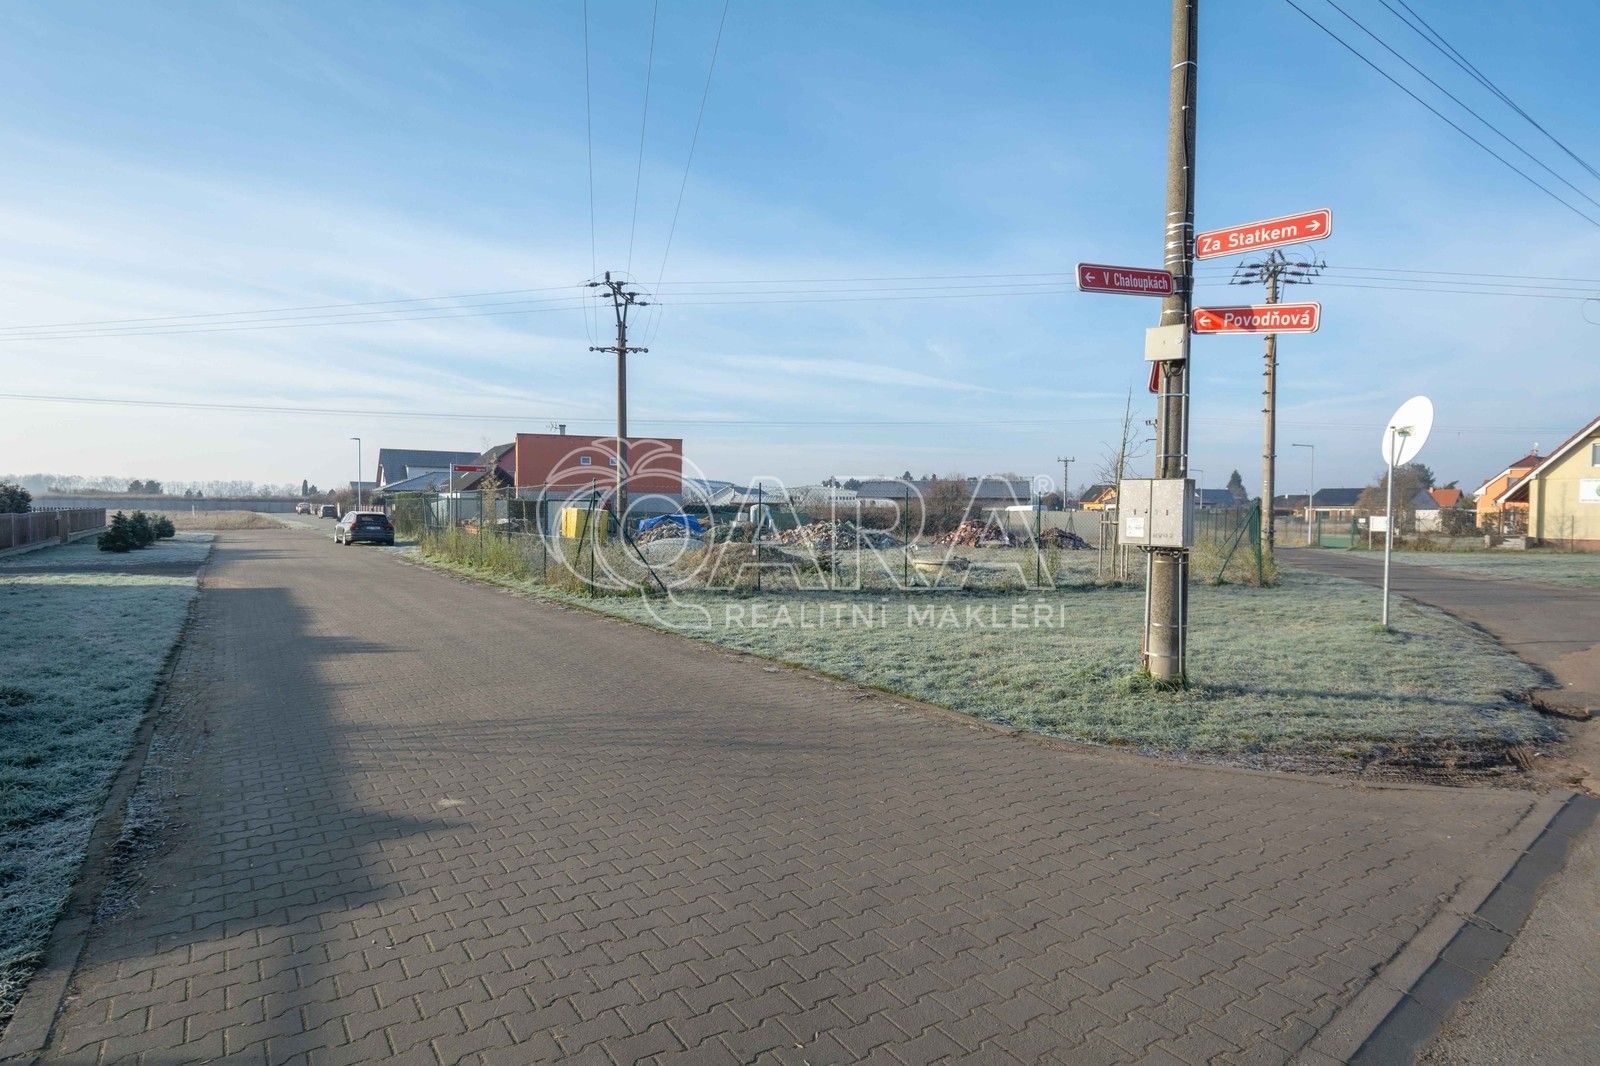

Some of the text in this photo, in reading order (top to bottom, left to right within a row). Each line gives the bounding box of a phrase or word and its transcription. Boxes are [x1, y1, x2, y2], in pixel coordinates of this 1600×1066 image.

[1202, 225, 1298, 253] Za Statkem
[1102, 271, 1169, 291] V Chaloupkách
[1223, 309, 1311, 328] Povodňová
